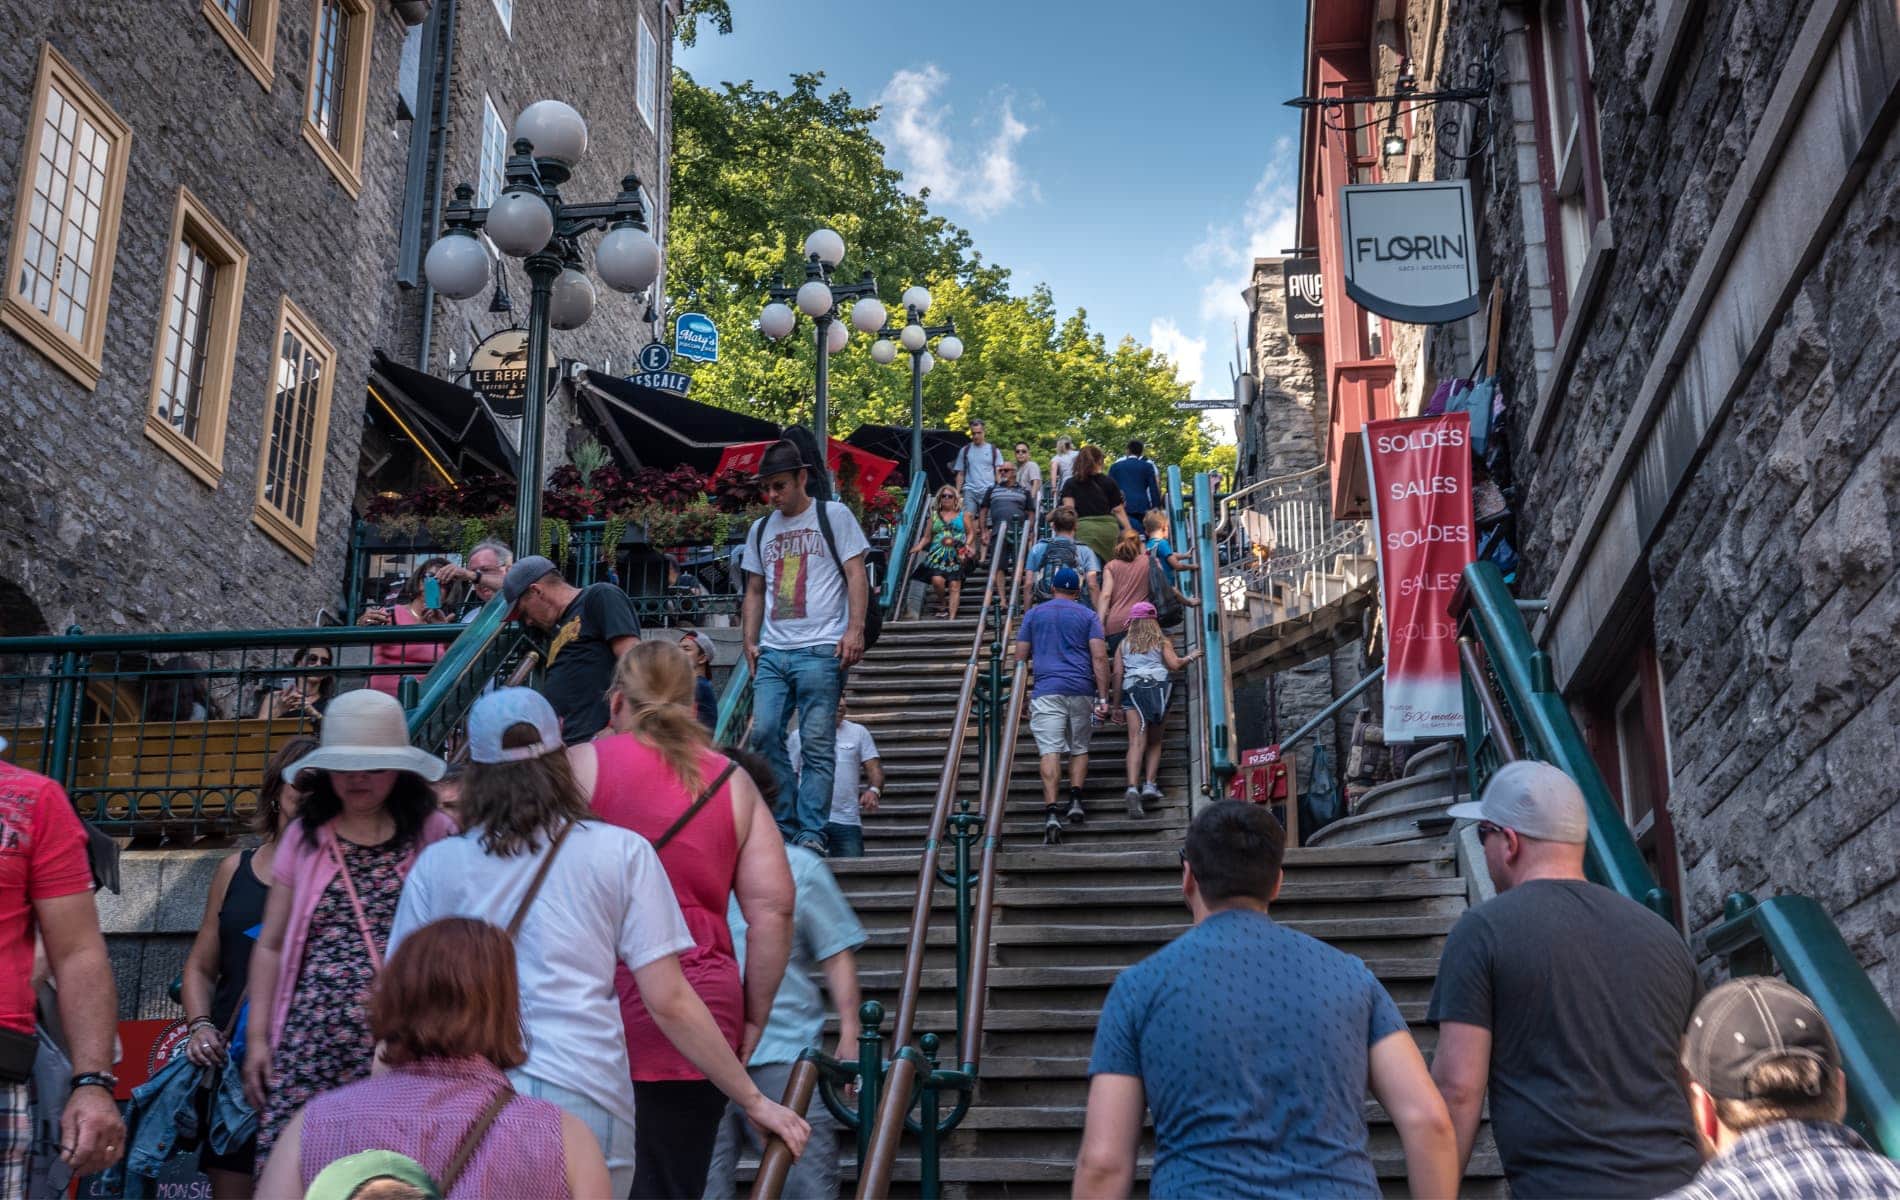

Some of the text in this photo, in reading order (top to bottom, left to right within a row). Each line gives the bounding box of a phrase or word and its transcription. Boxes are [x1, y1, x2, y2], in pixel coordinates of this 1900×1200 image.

[1356, 234, 1464, 263] FLORIN
[679, 329, 716, 352] Mary's
[649, 348, 660, 367] E
[476, 371, 491, 382] LE
[1377, 429, 1464, 454] SOLDES
[1391, 477, 1458, 500] SALES
[1387, 525, 1470, 550] SOLDES
[1400, 573, 1462, 596] SALES
